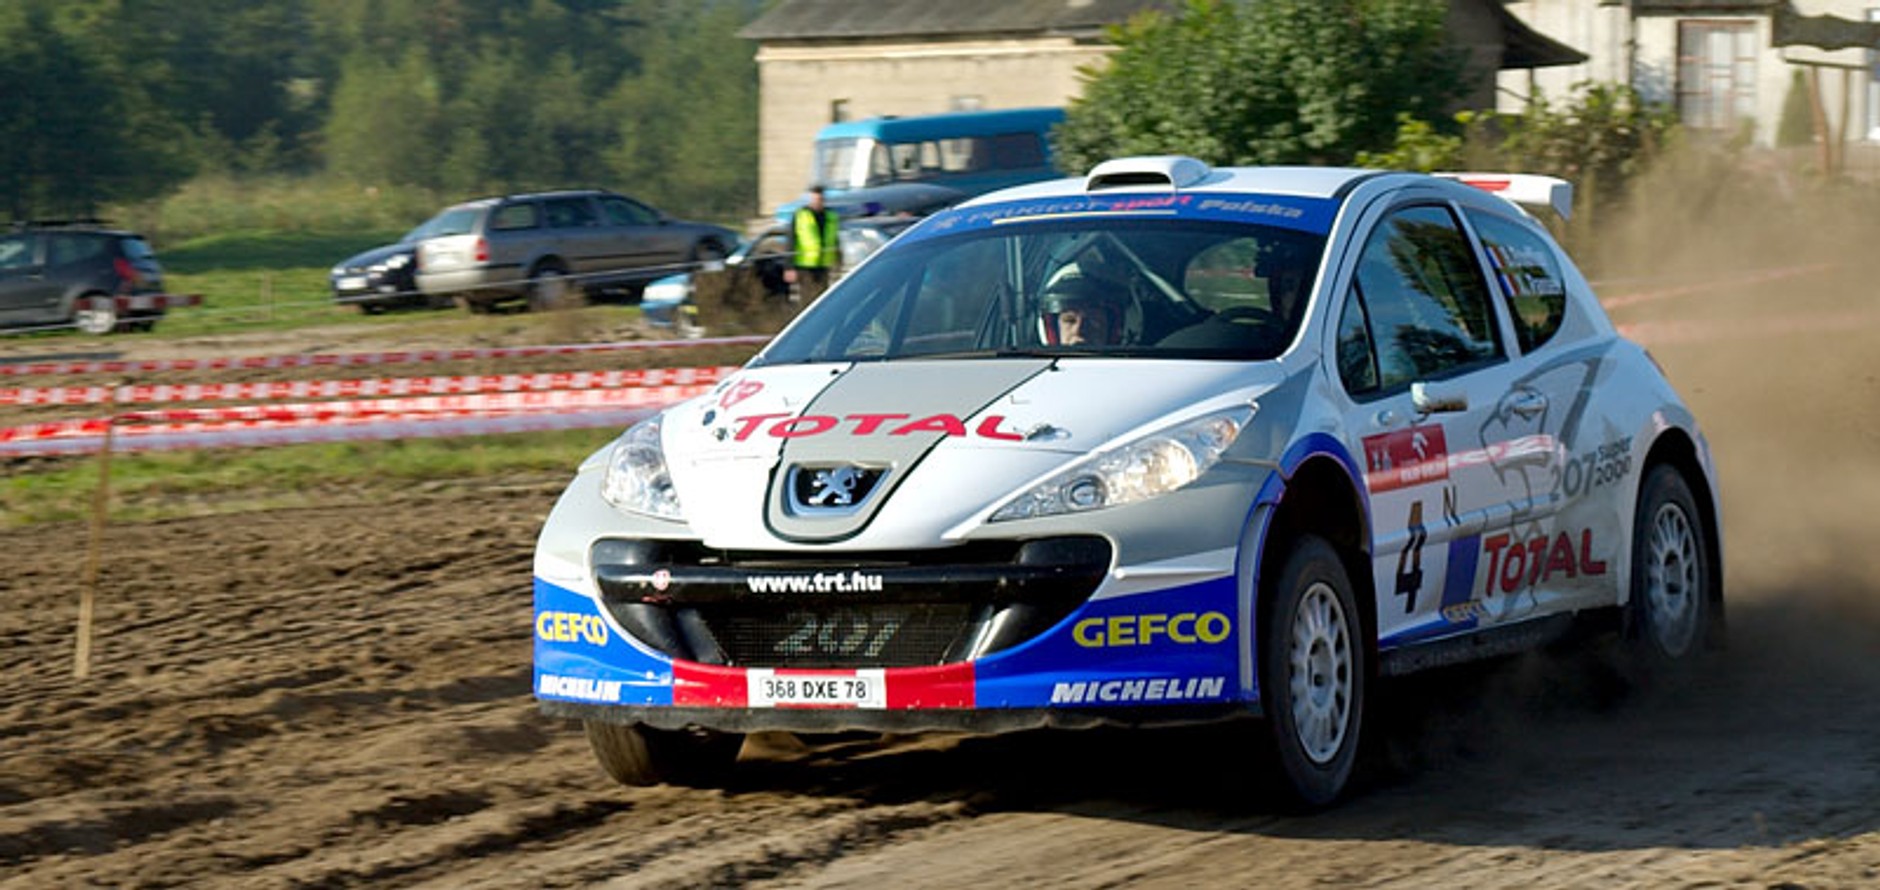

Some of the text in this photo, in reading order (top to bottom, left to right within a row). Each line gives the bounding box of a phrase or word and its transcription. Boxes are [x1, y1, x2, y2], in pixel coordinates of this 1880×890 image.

[1198, 199, 1304, 219] Polska
[734, 413, 1024, 442] TOTAL
[1549, 452, 1598, 502] 207
[1394, 500, 1427, 614] 4
[1485, 528, 1606, 597] TOTAL
[747, 571, 883, 593] www.trt.hu
[536, 610, 609, 647] GEFCO
[1072, 611, 1232, 647] GEFCO
[538, 674, 622, 701] MICHELIN
[765, 680, 867, 699] 368 DXE 78
[1051, 676, 1226, 704] MICHELIN
